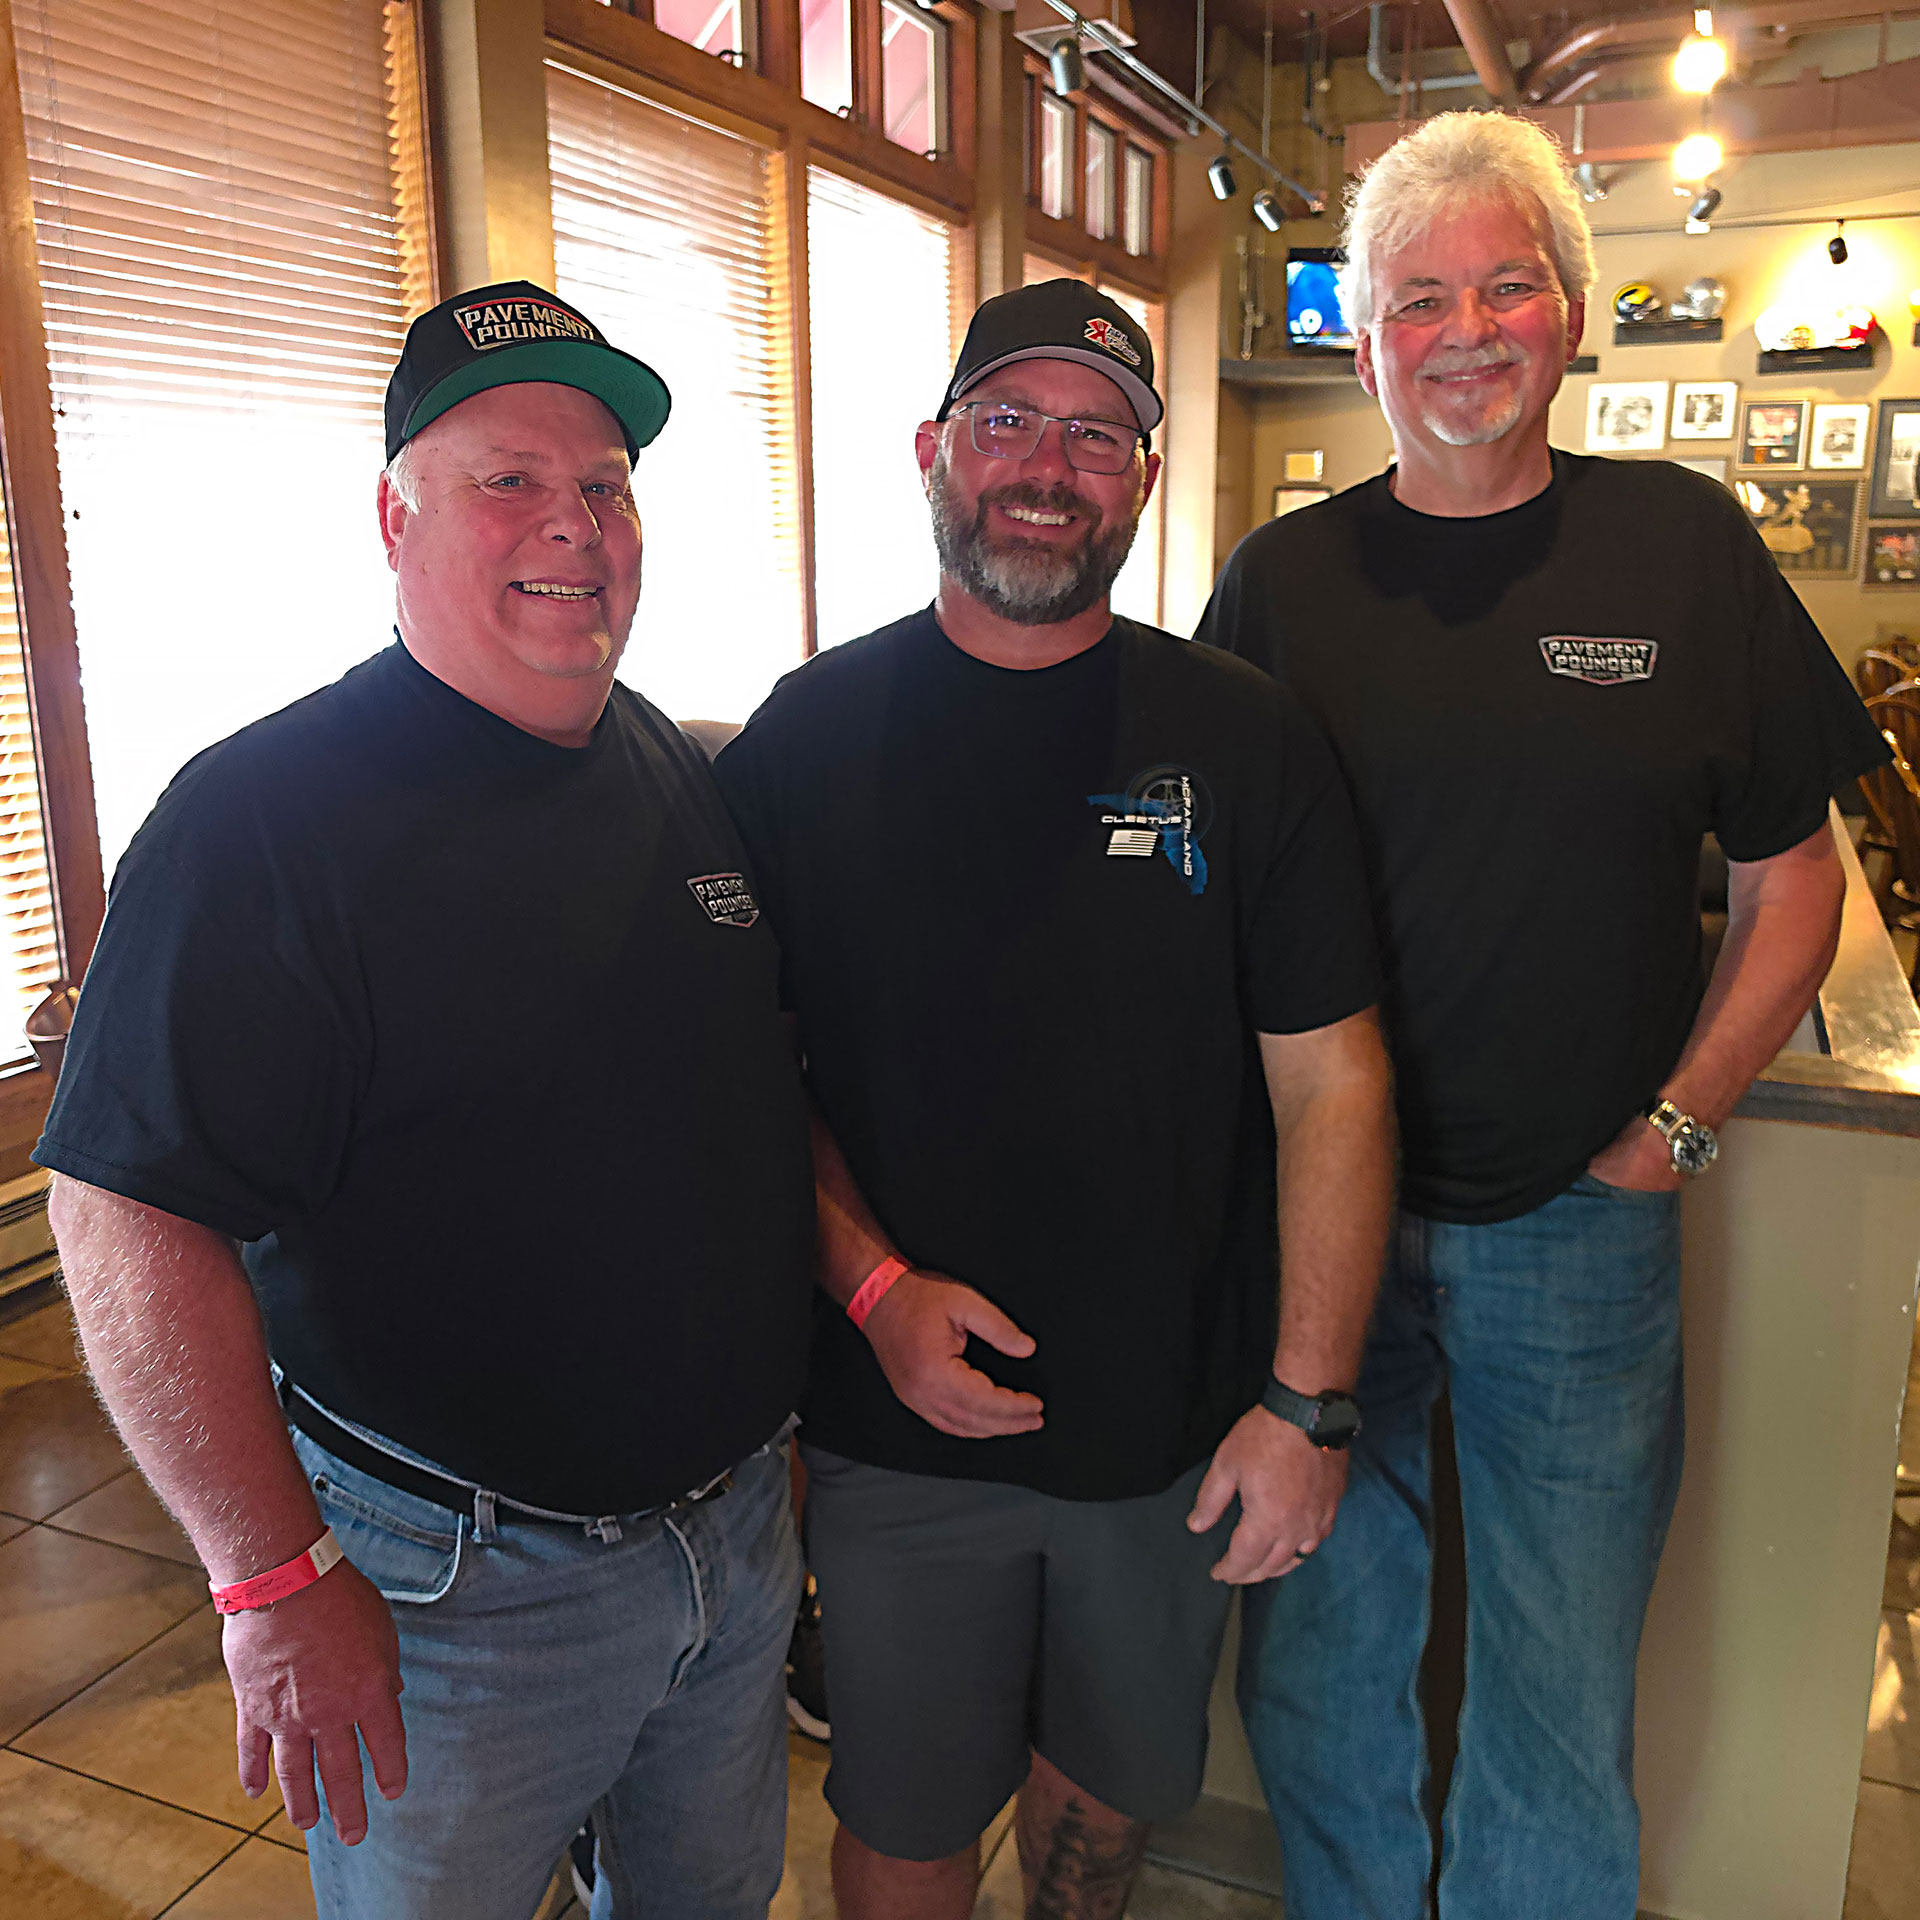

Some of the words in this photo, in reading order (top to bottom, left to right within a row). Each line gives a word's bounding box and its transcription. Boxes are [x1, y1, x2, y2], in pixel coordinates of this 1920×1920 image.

[464, 304, 587, 339] PAVEMENT
[477, 322, 574, 343] POUND
[1548, 641, 1649, 659] PAVEMENT
[1555, 655, 1644, 673] POUNDER
[1101, 815, 1182, 824] CLEETUS
